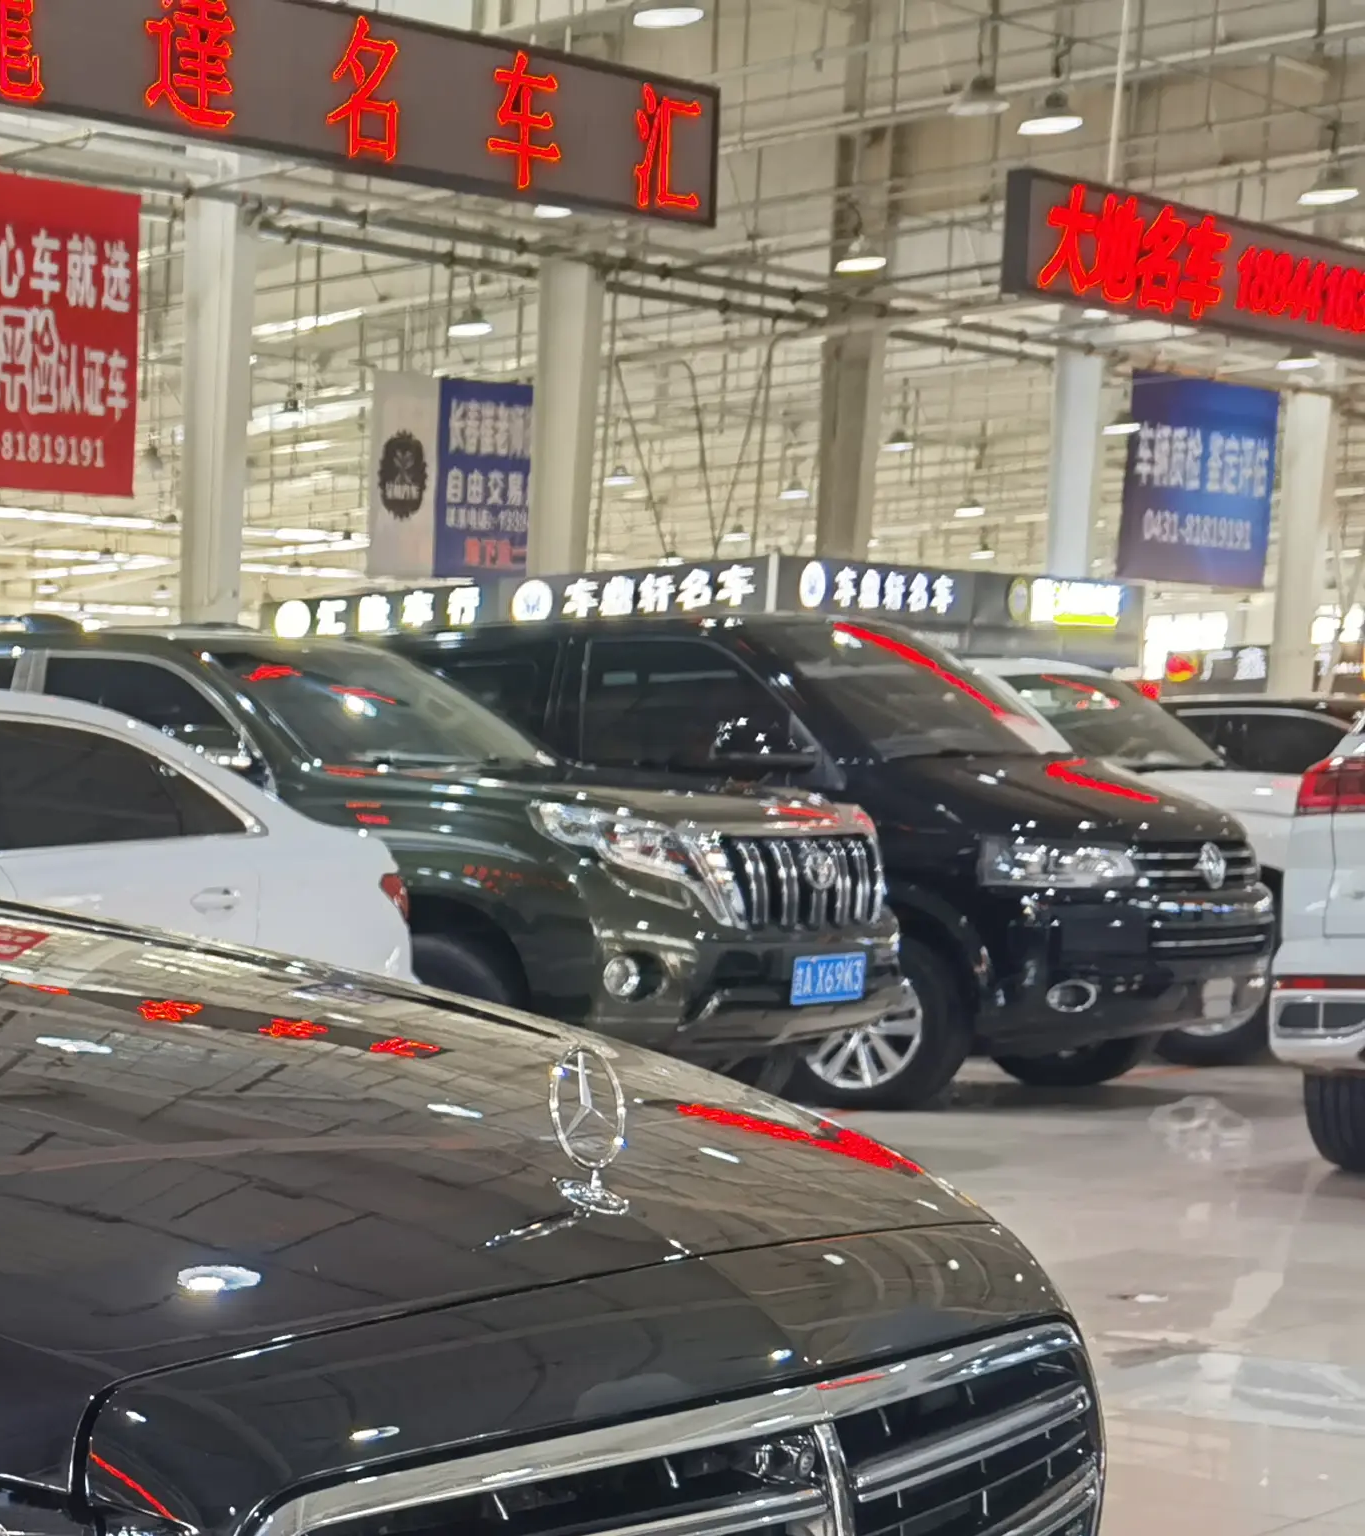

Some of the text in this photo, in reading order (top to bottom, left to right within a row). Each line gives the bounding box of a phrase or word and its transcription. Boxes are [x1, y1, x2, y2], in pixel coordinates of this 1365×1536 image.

[1037, 184, 1232, 321] 大地名车
[446, 466, 528, 506] 自由交易
